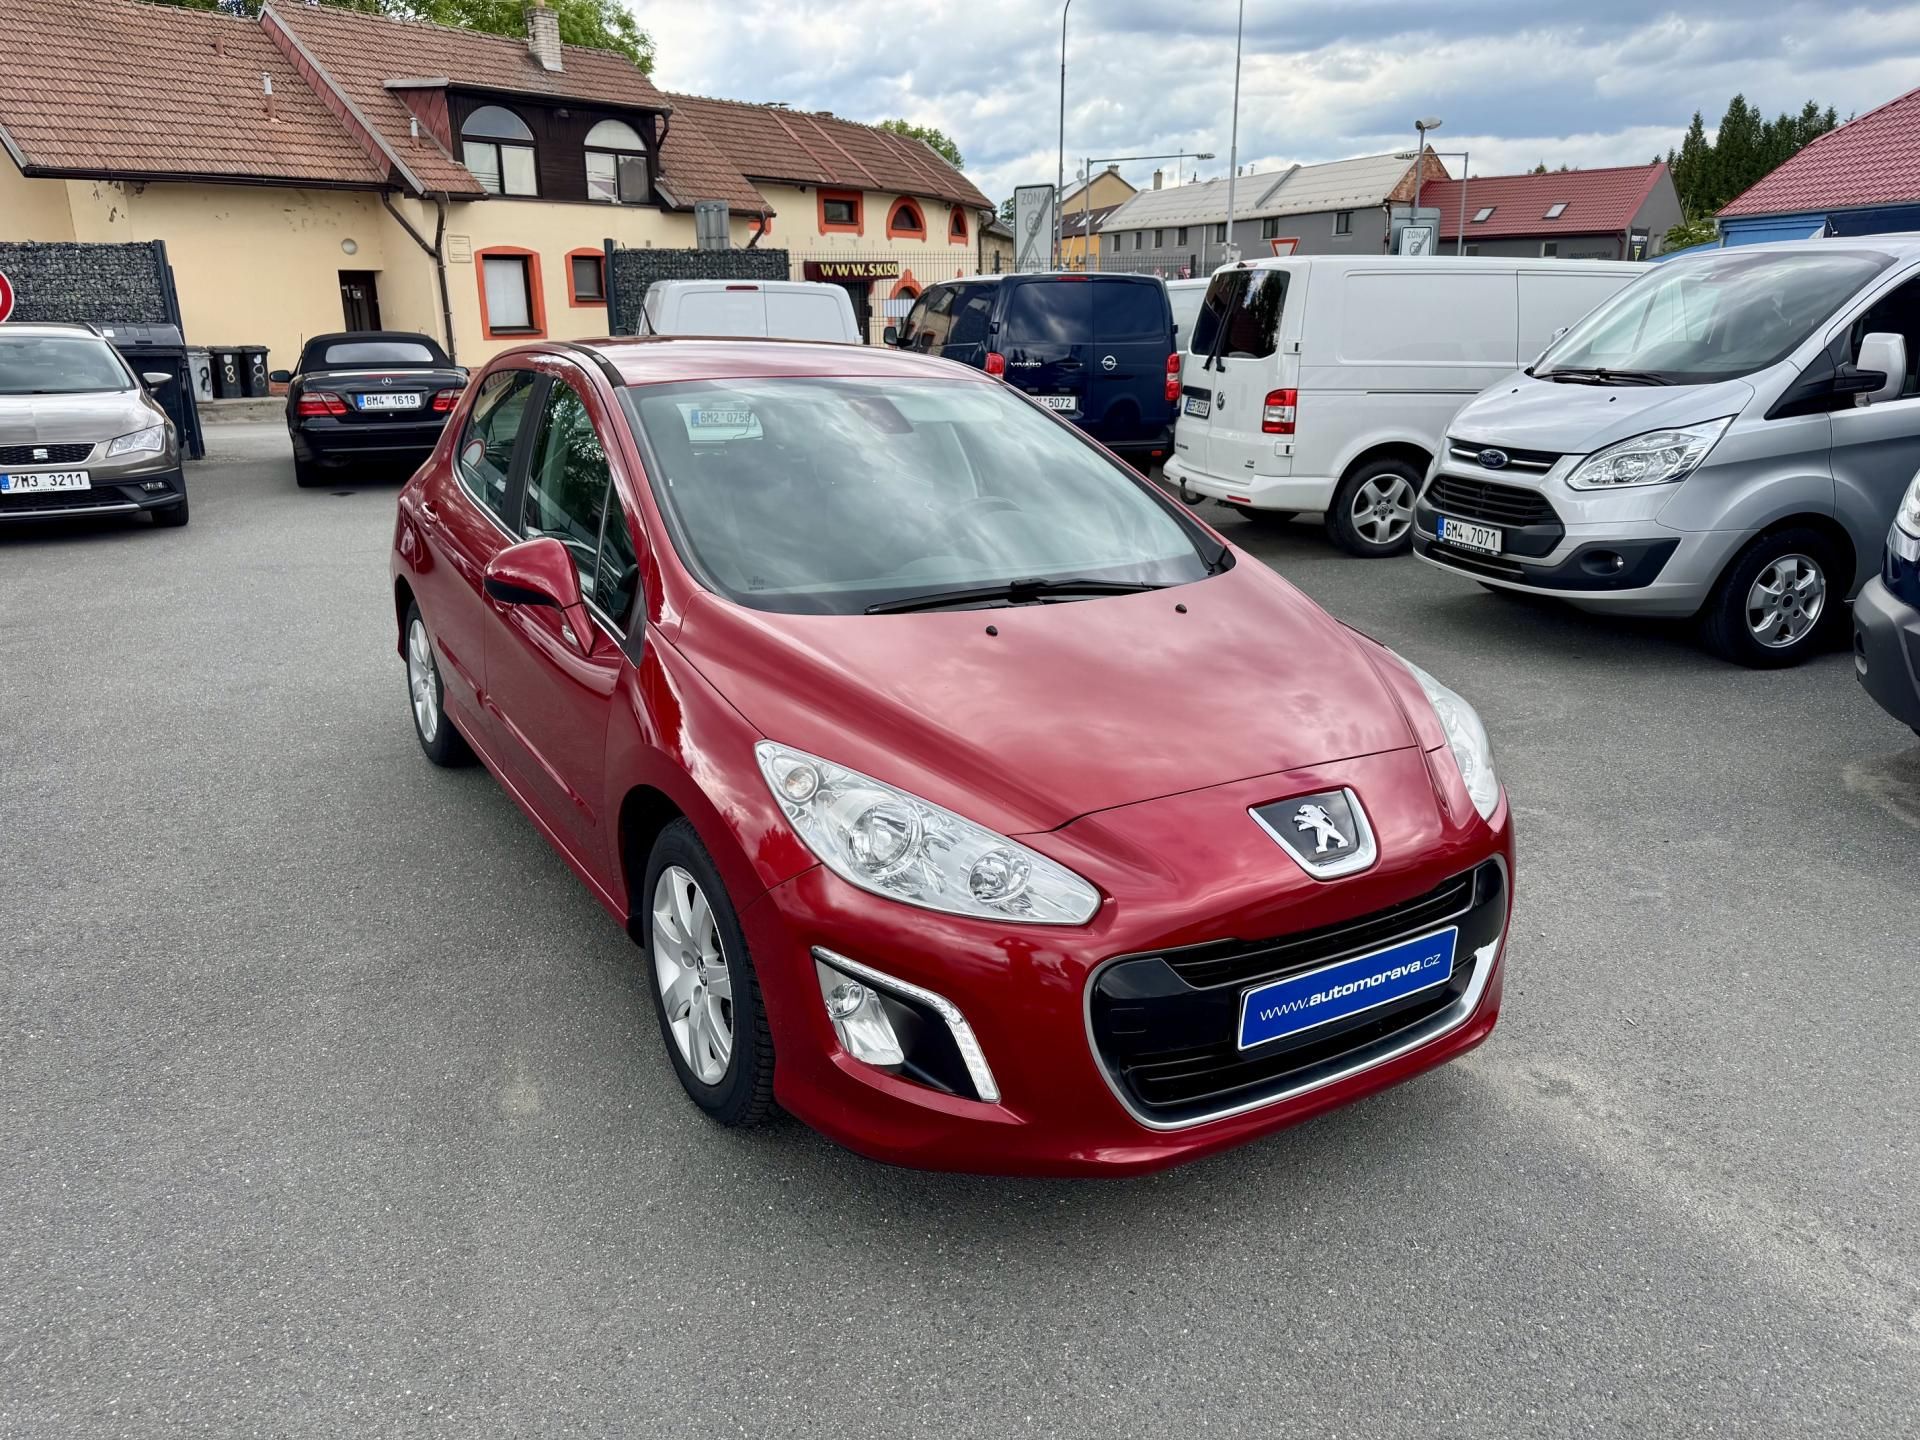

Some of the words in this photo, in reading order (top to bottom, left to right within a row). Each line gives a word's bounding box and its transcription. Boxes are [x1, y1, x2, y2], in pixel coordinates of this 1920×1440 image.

[366, 395, 384, 406] 8M4
[392, 395, 416, 405] 1619
[1048, 397, 1071, 408] 5072
[701, 412, 719, 423] 6M2
[12, 475, 38, 488] 7M3
[49, 473, 83, 487] 3211
[1445, 521, 1463, 540] 6M4
[1471, 527, 1496, 549] 7071
[1260, 953, 1441, 1022] www.automorava.cz
